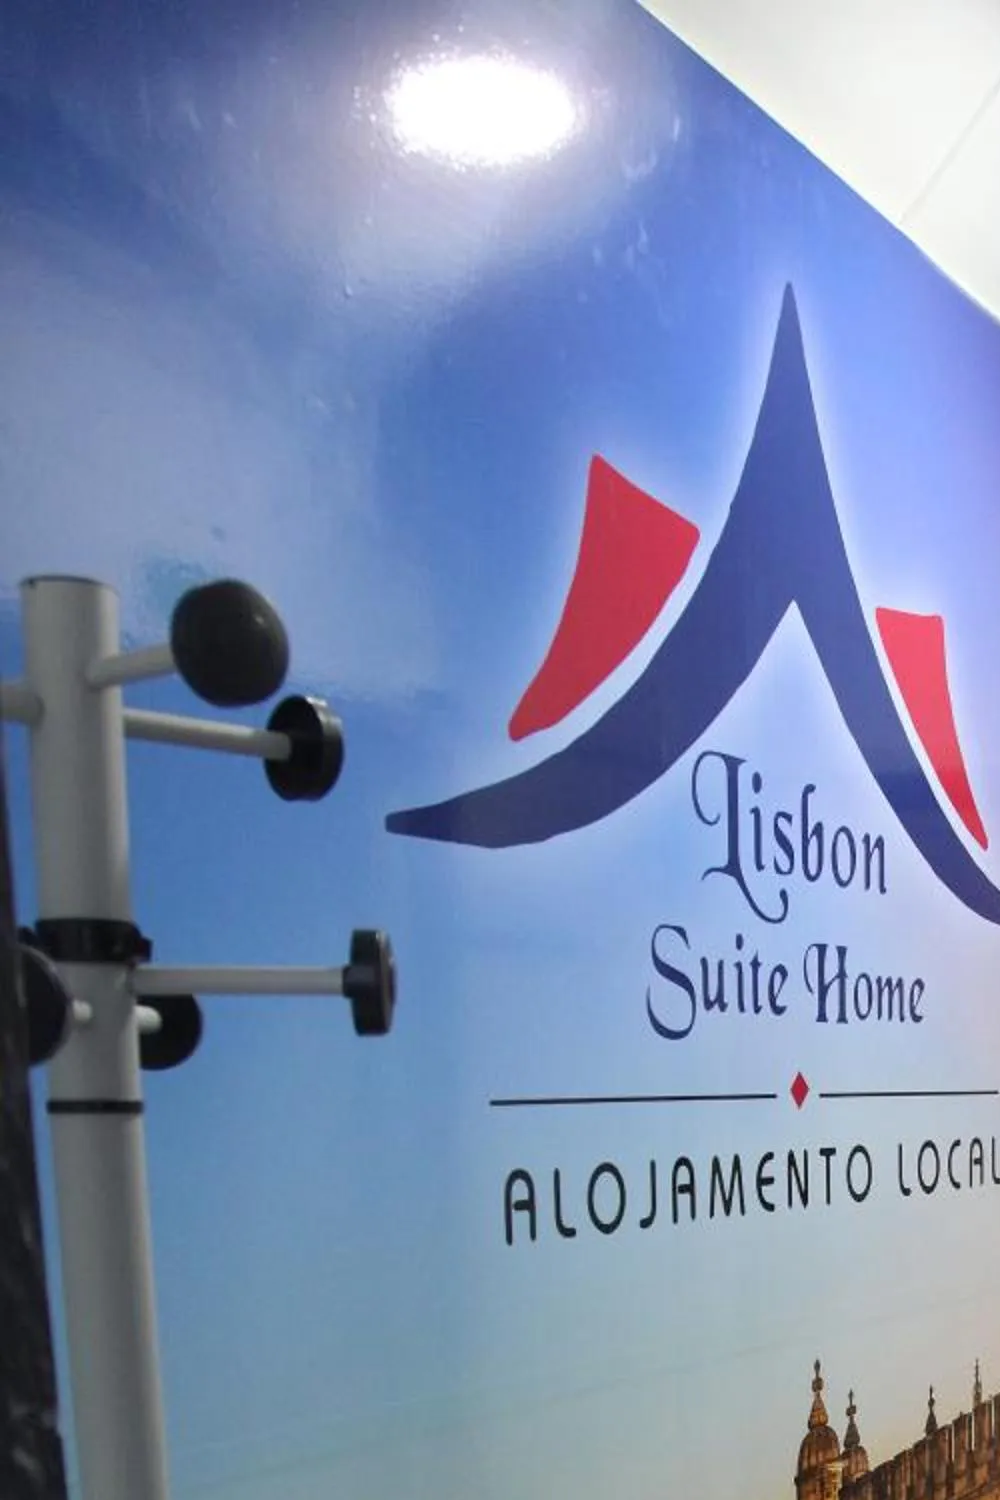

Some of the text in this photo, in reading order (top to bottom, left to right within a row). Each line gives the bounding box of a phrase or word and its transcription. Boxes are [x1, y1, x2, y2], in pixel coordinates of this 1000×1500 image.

[691, 750, 887, 924] Lisbon
[646, 923, 926, 1041] Suite Home
[504, 1144, 873, 1246] ALOJAMENTO
